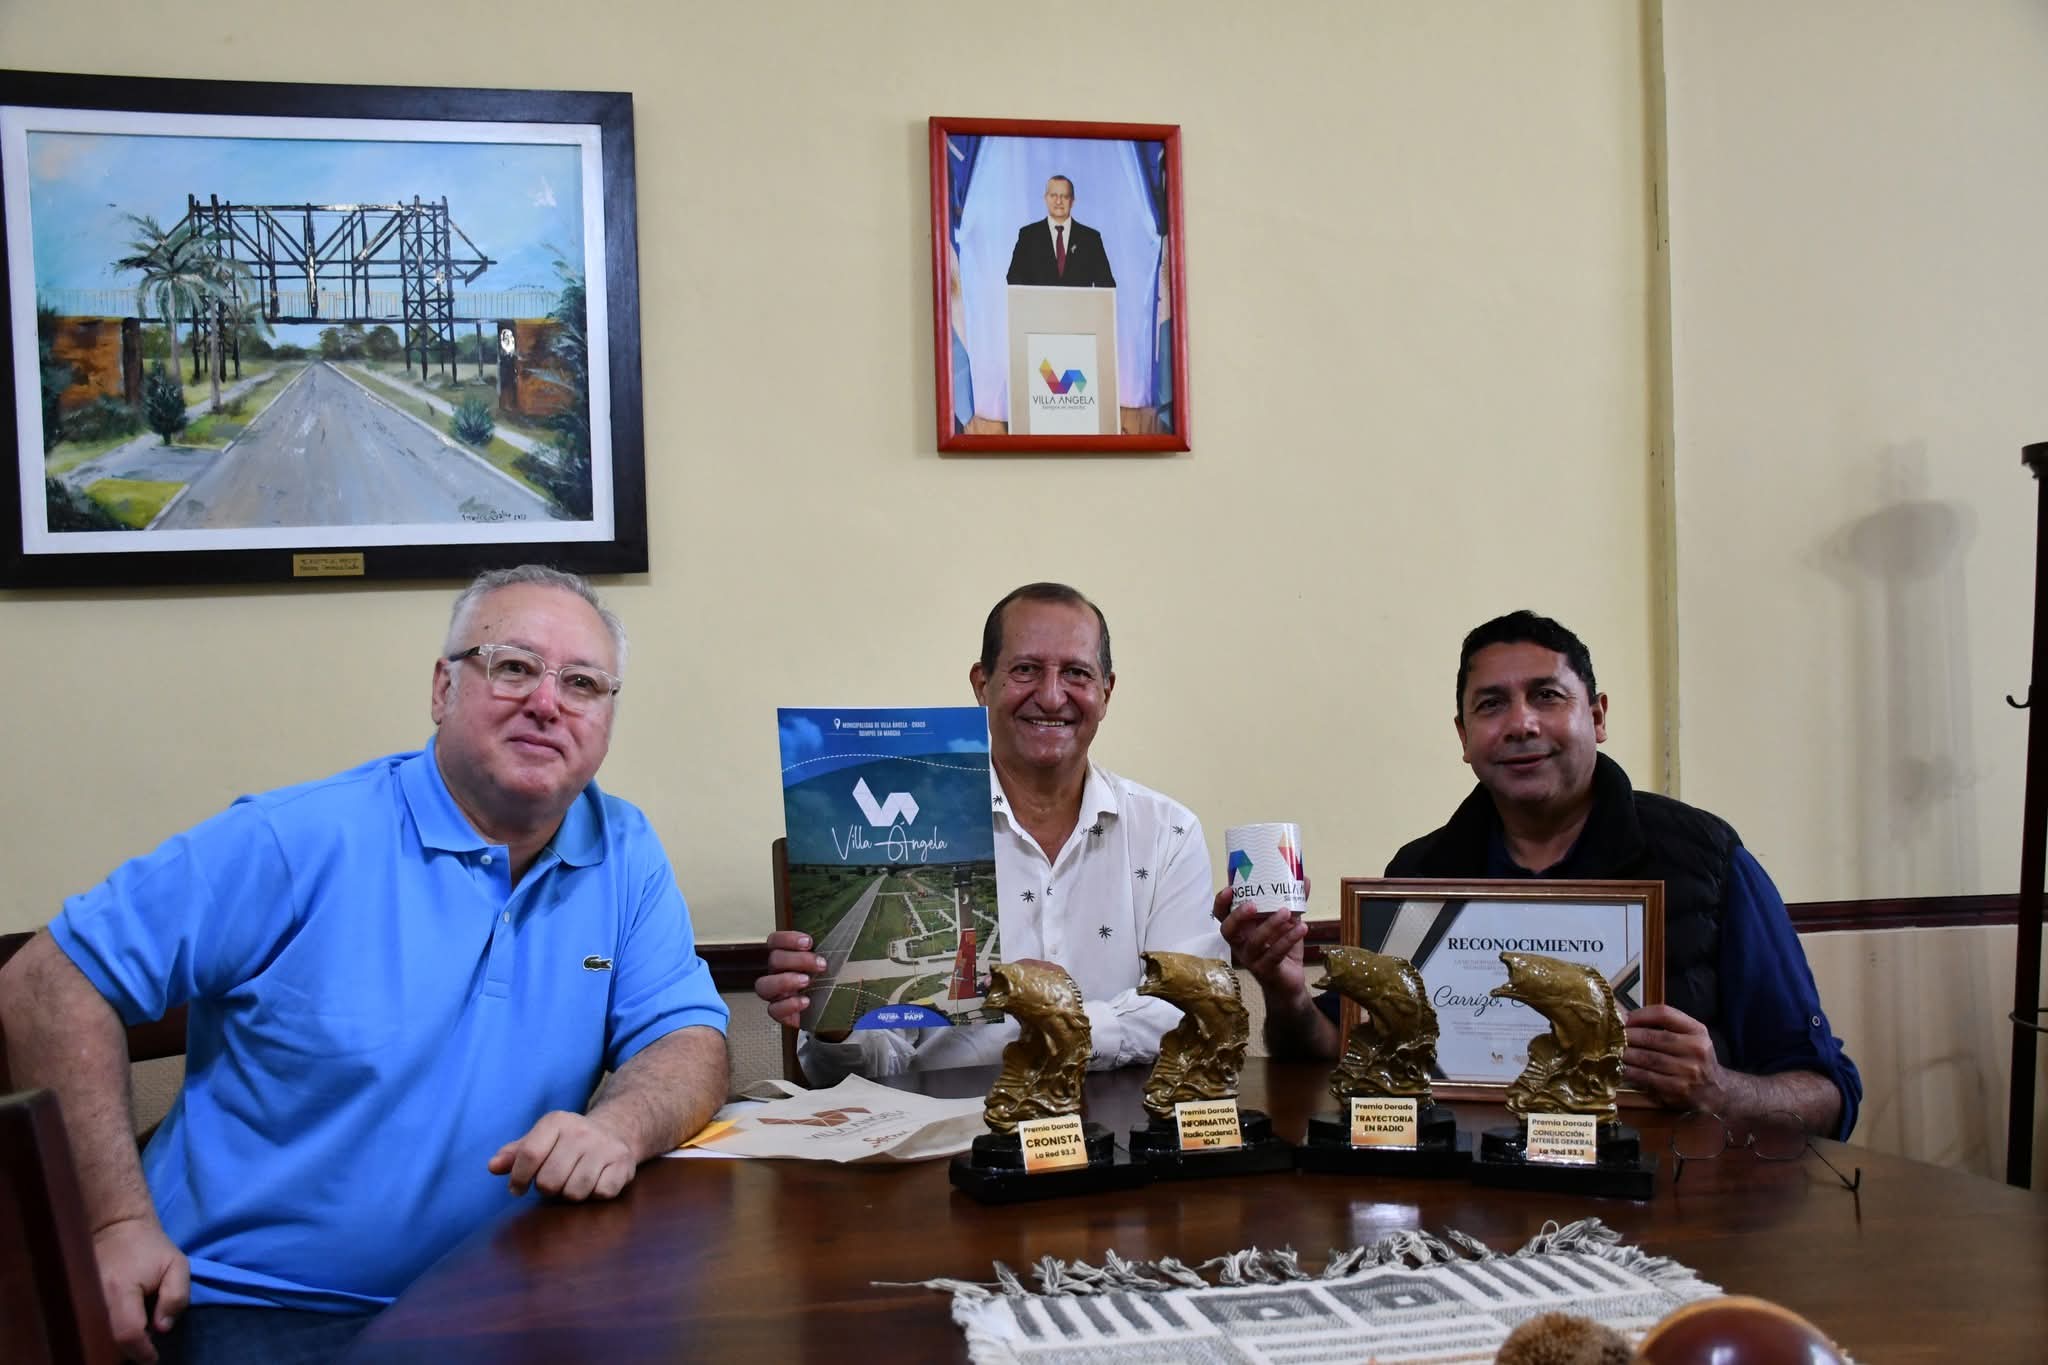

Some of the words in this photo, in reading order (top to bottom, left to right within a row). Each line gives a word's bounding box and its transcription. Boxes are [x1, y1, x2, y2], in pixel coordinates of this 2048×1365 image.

[1032, 395, 1056, 405] VILLA
[831, 824, 872, 860] Villa
[1232, 885, 1265, 898] NGELA
[1447, 937, 1604, 953] RECONOCIMIENTO
[1180, 1109, 1207, 1117] Premio
[1207, 1106, 1235, 1115] Dorado
[1051, 1122, 1078, 1130] Dorado
[1181, 1118, 1236, 1127] INFORMATIVO
[1532, 1119, 1561, 1127] Premio
[1183, 1130, 1204, 1139] Radio
[1204, 1129, 1233, 1138] Cadena
[1533, 1129, 1585, 1137] CONDUCCIÓN
[1026, 1134, 1081, 1148] CRONISTA
